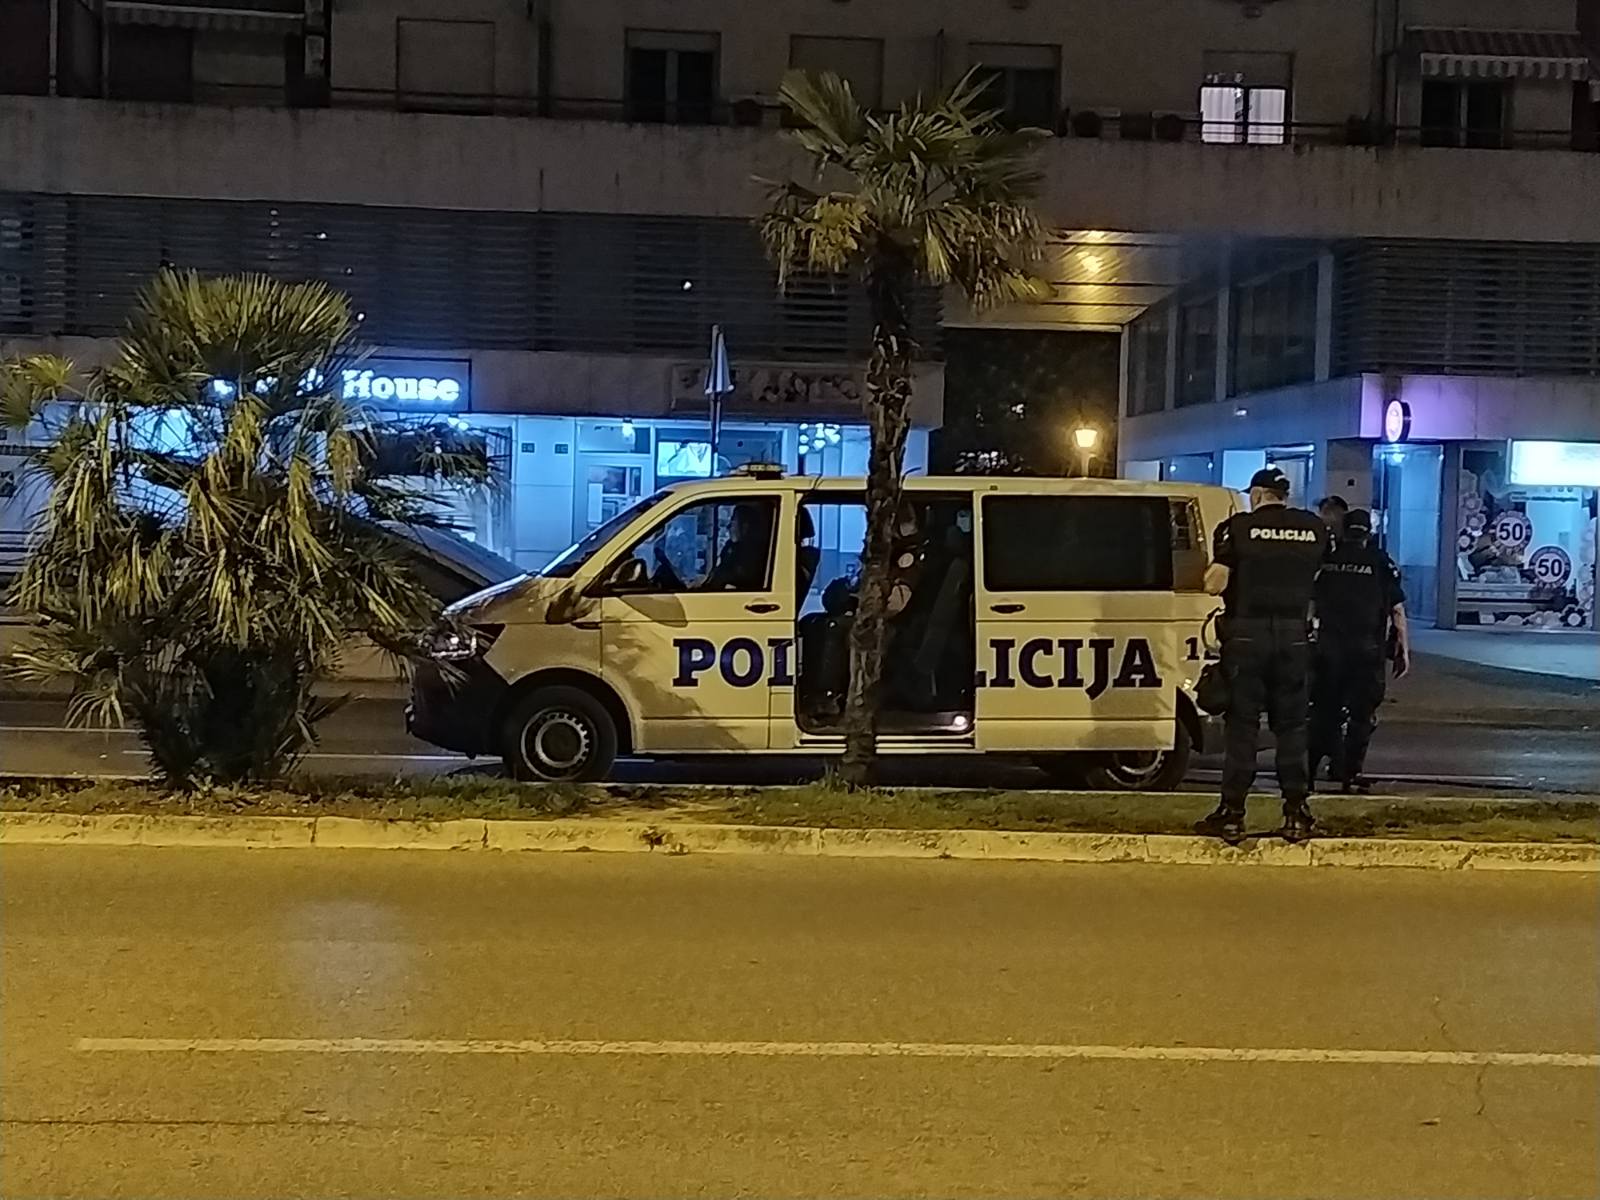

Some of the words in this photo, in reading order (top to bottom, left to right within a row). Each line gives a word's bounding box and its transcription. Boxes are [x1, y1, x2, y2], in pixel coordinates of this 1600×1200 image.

[341, 369, 460, 401] House
[1250, 528, 1317, 542] POLICIJA
[1499, 522, 1524, 541] 50
[1537, 558, 1562, 577] 50
